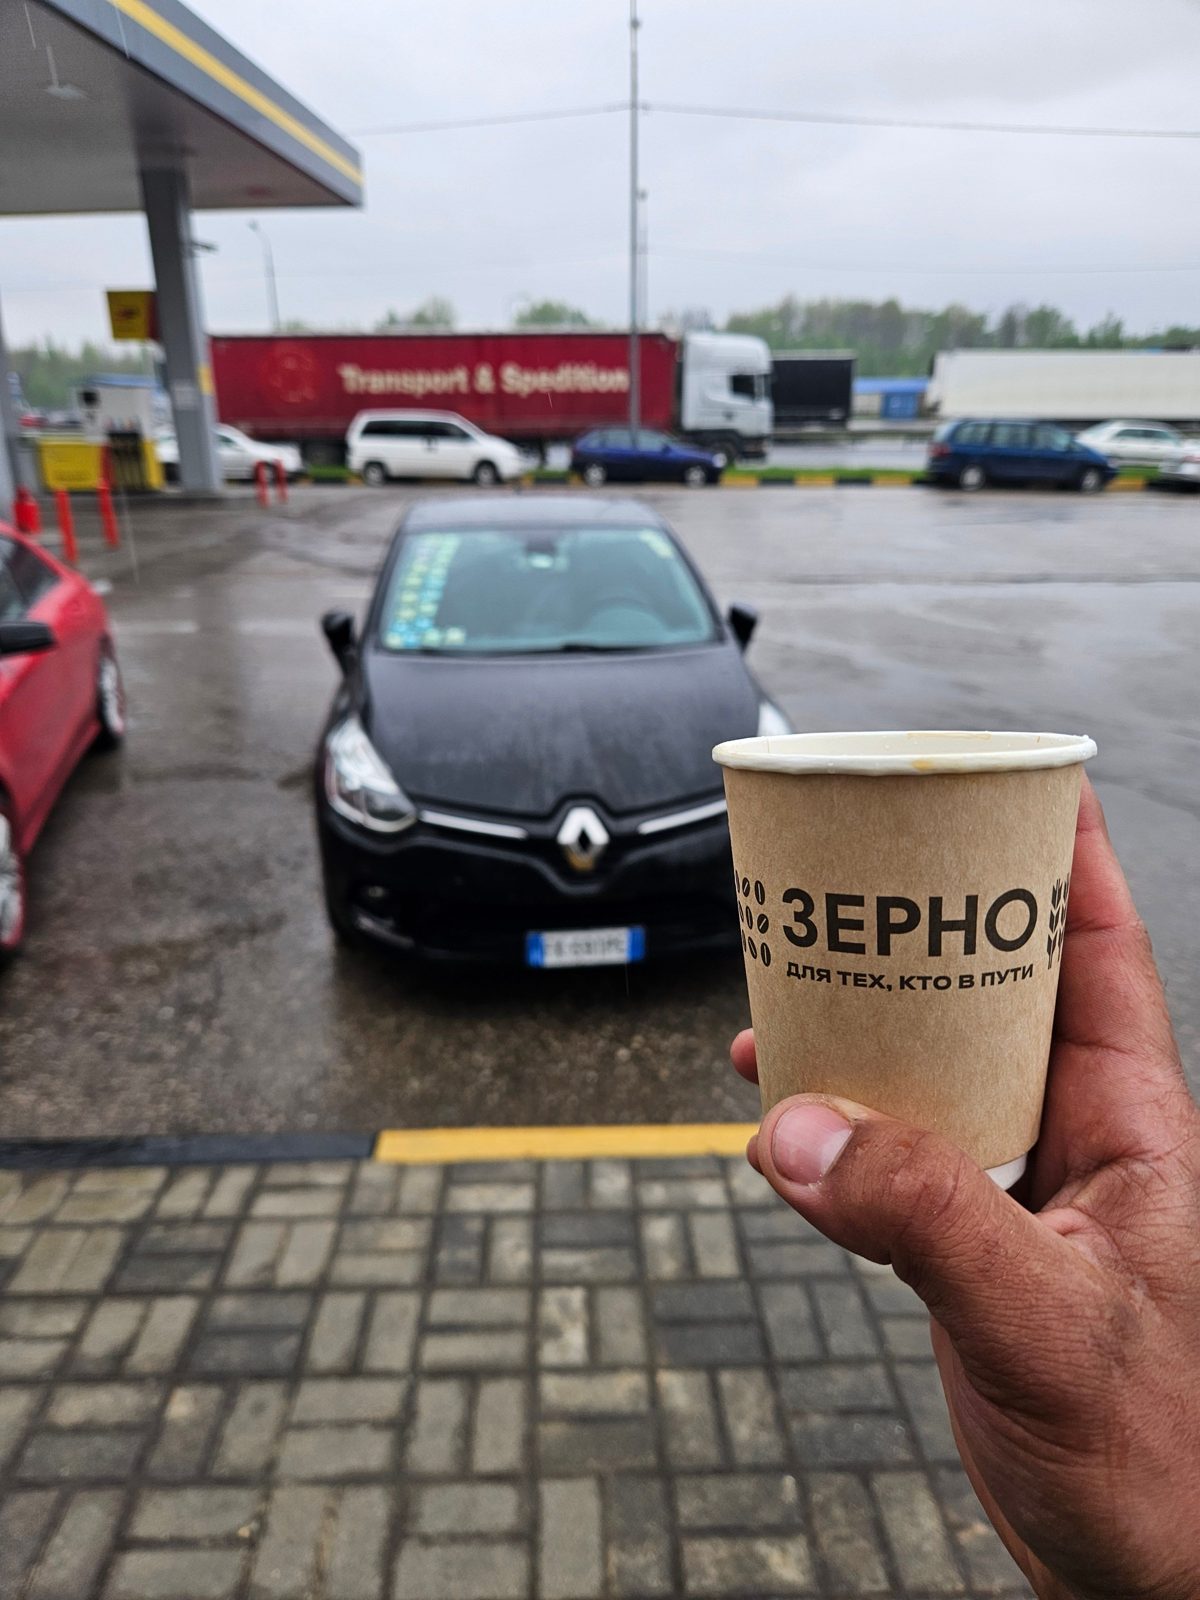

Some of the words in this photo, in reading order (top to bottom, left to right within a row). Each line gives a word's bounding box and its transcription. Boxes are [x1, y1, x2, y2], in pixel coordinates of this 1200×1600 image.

[339, 363, 469, 396] Transport
[474, 364, 496, 393] &
[500, 362, 630, 396] Spedition
[782, 888, 1038, 957] ЗЕРНО
[787, 961, 832, 983] ДЛЯ
[837, 970, 894, 991] ТЕХ,
[899, 974, 953, 990] КТО
[958, 974, 975, 989] В
[981, 964, 1034, 987] ПУТИ
